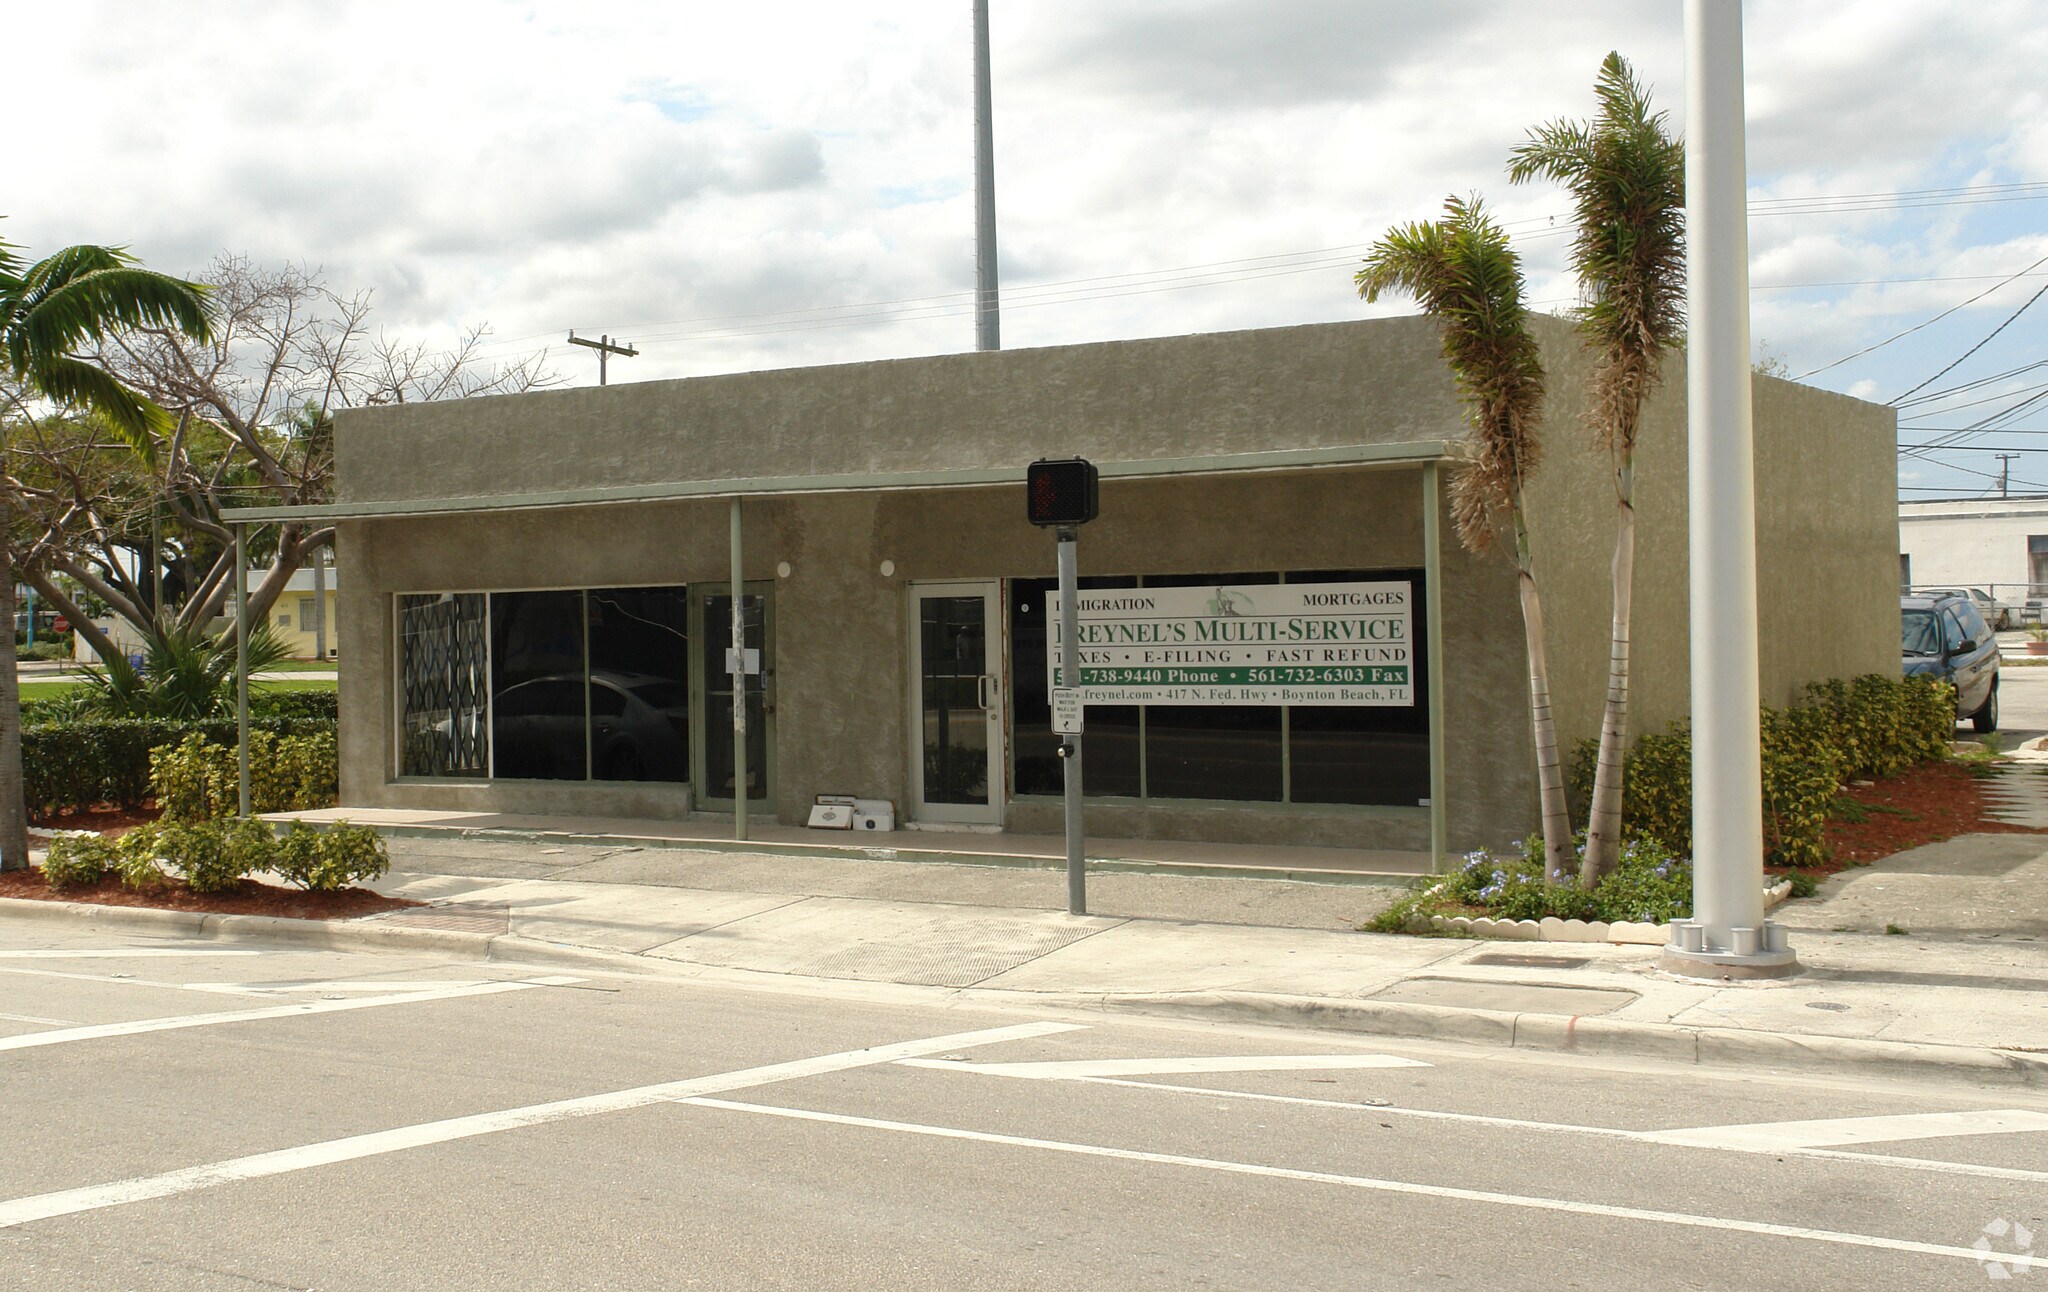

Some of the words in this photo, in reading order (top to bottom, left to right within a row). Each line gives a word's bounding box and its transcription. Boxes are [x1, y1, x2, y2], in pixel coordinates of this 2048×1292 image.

[1056, 598, 1155, 611] IMIGRATION
[1303, 592, 1404, 606] MORTGAGES
[1194, 618, 1404, 642] MULTI-SERVICE
[1054, 651, 1111, 663] TXES
[1144, 650, 1231, 663] E-FILING
[1267, 650, 1314, 662] FAST
[1323, 648, 1406, 661] REFUND
[1056, 669, 1161, 683] 51-738-9440
[1168, 669, 1219, 682] Phone
[1248, 668, 1364, 682] 561-732-6303
[1371, 668, 1404, 682] Fax
[1166, 689, 1186, 699] 417
[1192, 689, 1205, 699] N.
[1210, 689, 1236, 699] Fed.
[1240, 689, 1268, 702] Hwy
[1282, 689, 1335, 702] Boynton
[1341, 689, 1384, 701] Beach,
[1389, 689, 1407, 700] FL
